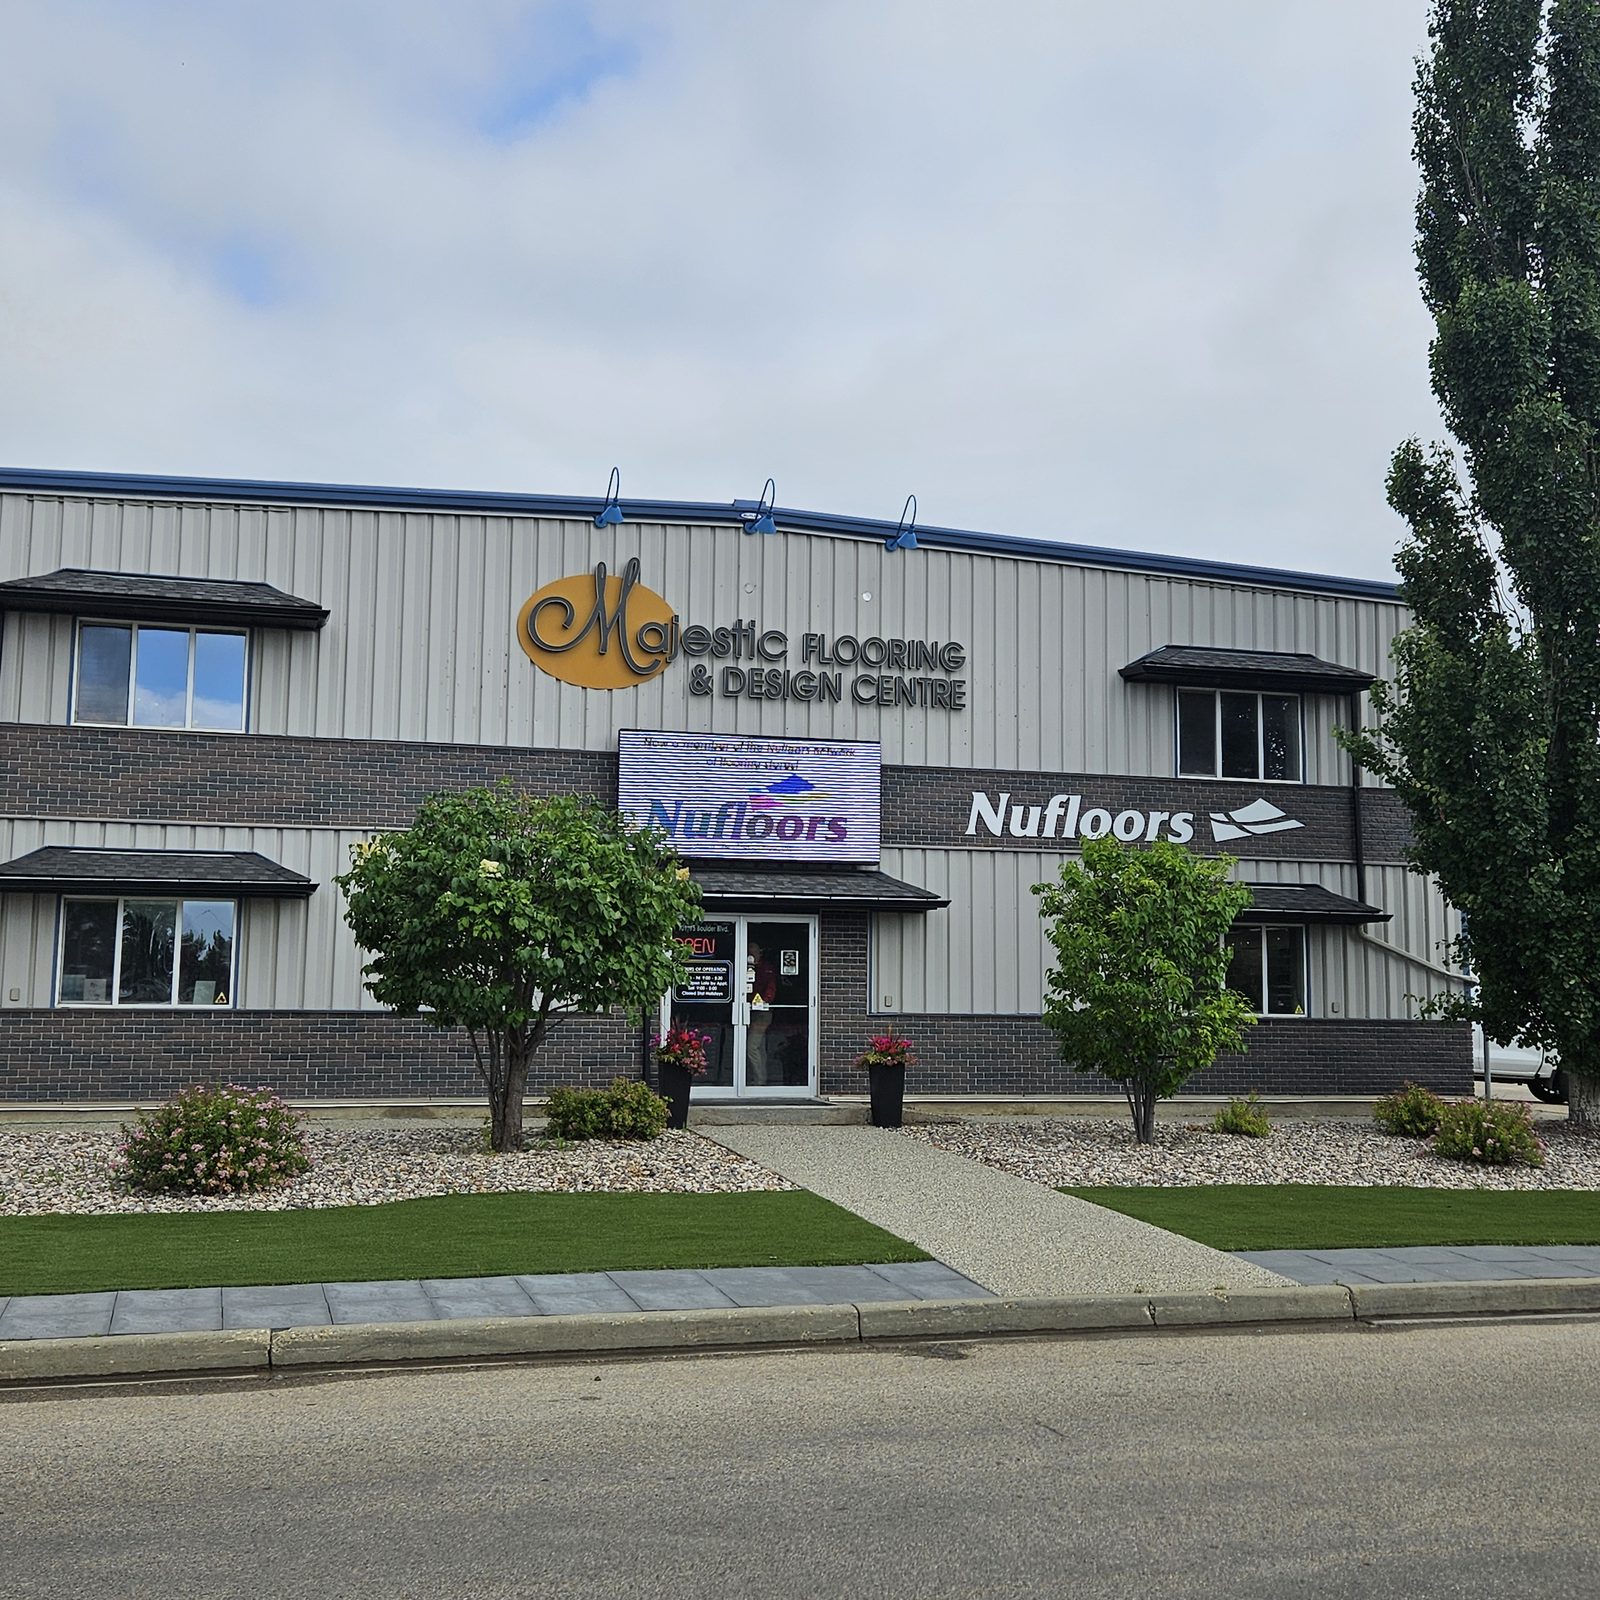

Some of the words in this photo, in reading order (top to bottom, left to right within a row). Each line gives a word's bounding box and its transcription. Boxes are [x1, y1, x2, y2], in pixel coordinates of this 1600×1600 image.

[527, 556, 789, 676] Majestic
[801, 632, 967, 671] FLOORING
[688, 664, 714, 697] &
[722, 665, 842, 703] DESIGN
[851, 673, 967, 710] CENTRE
[648, 799, 848, 842] Nufloors
[965, 791, 1194, 844] Nufloors
